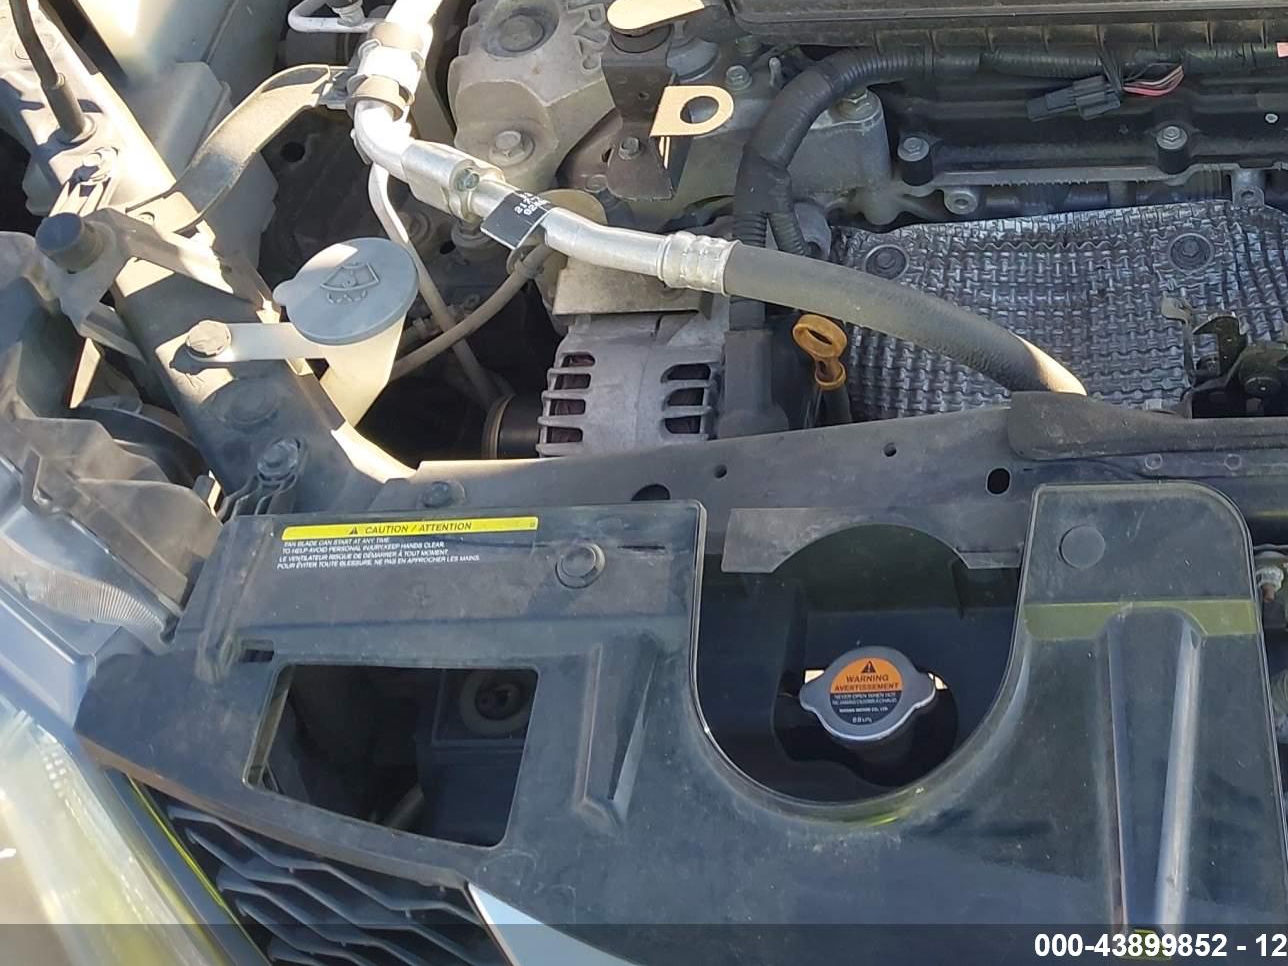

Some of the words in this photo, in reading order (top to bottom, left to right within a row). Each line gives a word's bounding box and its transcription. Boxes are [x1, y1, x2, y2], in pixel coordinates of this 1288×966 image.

[365, 525, 409, 534] CAUTION
[419, 521, 472, 532] ATTENTION
[329, 544, 362, 553] PERSONAL
[277, 562, 296, 570] POUR
[319, 560, 338, 568] TOUTE
[407, 555, 446, 564] APPROCHER
[446, 554, 459, 562] LES
[279, 555, 288, 563] LE
[289, 554, 329, 562] VENTILATEUR
[329, 553, 353, 561] RISQUE
[846, 674, 888, 682] WARNING
[835, 683, 899, 691] AVERTISSEMENT
